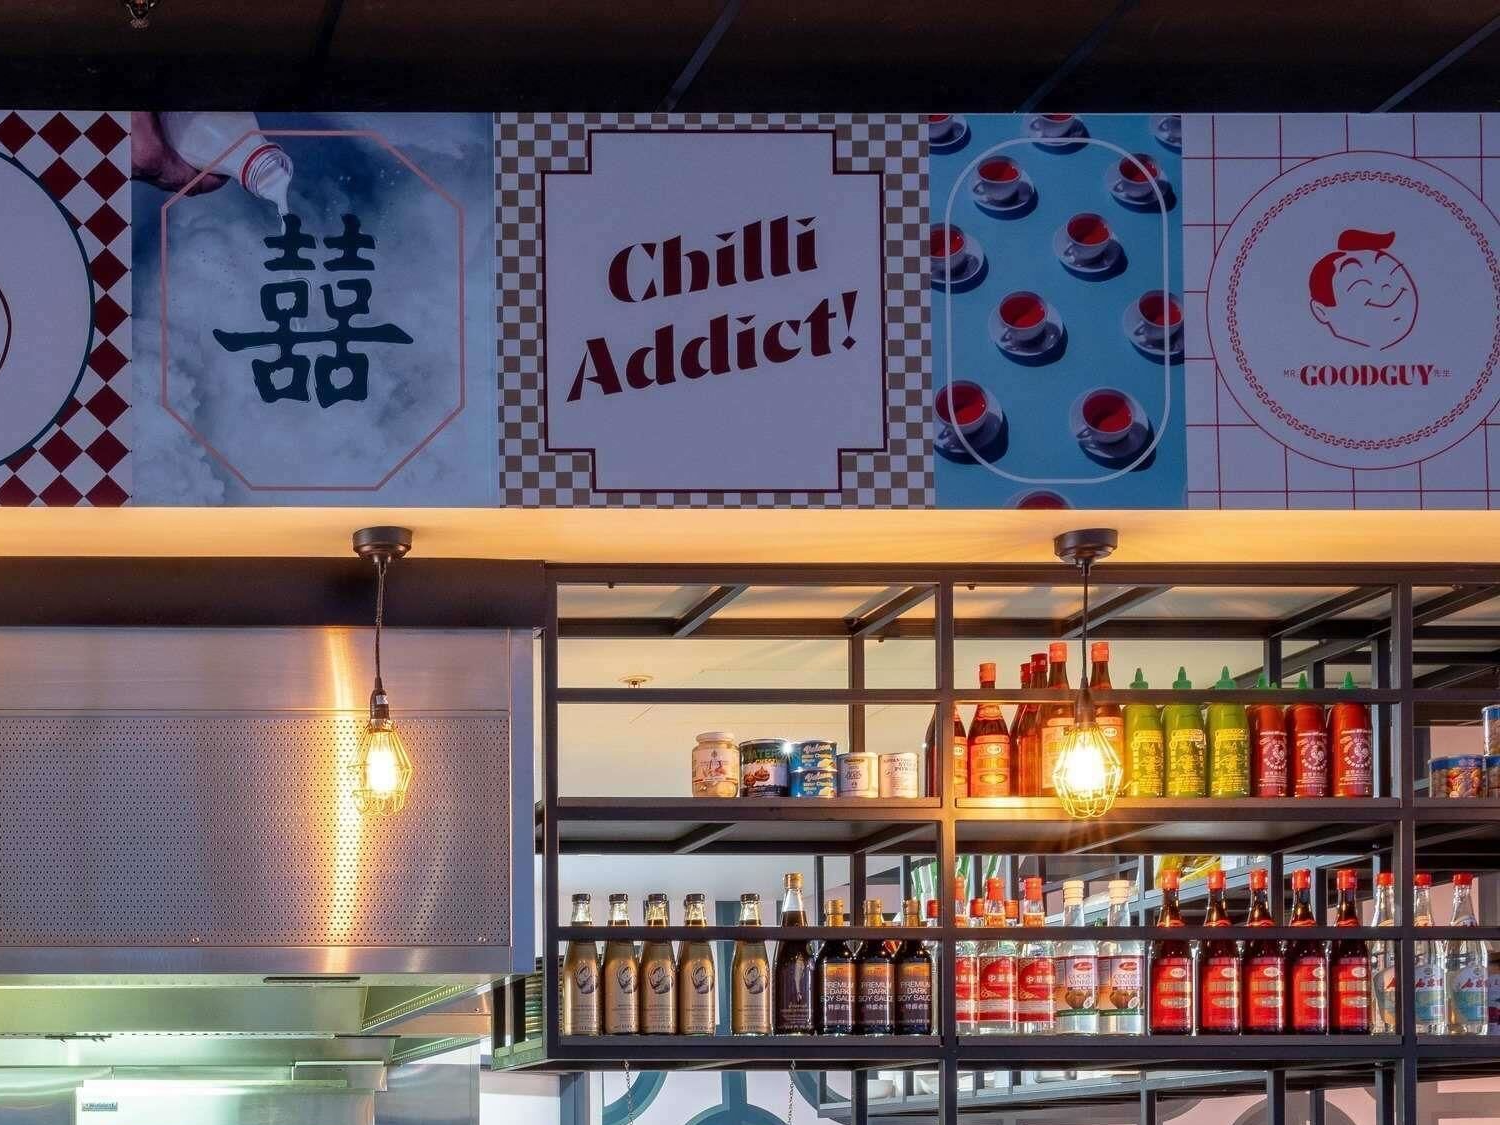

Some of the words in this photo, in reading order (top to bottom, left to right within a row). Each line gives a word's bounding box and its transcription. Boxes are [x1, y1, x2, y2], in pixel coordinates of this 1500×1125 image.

[607, 215, 819, 303] Chilli
[566, 290, 860, 403] Addict!
[1300, 364, 1434, 386] GOODGUY
